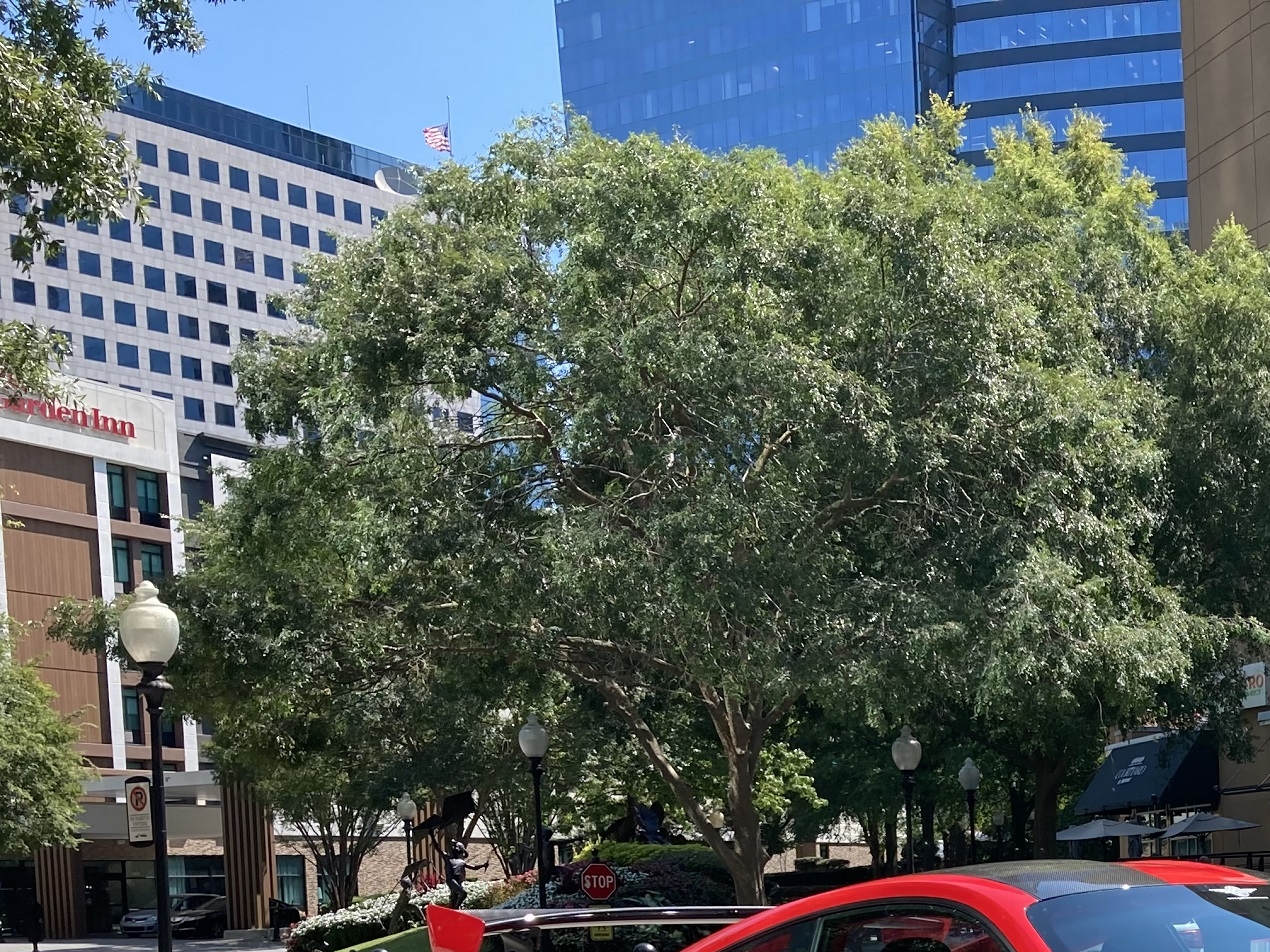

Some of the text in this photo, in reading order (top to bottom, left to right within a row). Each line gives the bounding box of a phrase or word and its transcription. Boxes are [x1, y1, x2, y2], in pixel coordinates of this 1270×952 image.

[0, 397, 137, 438] arden Inn
[584, 875, 613, 889] STOP
